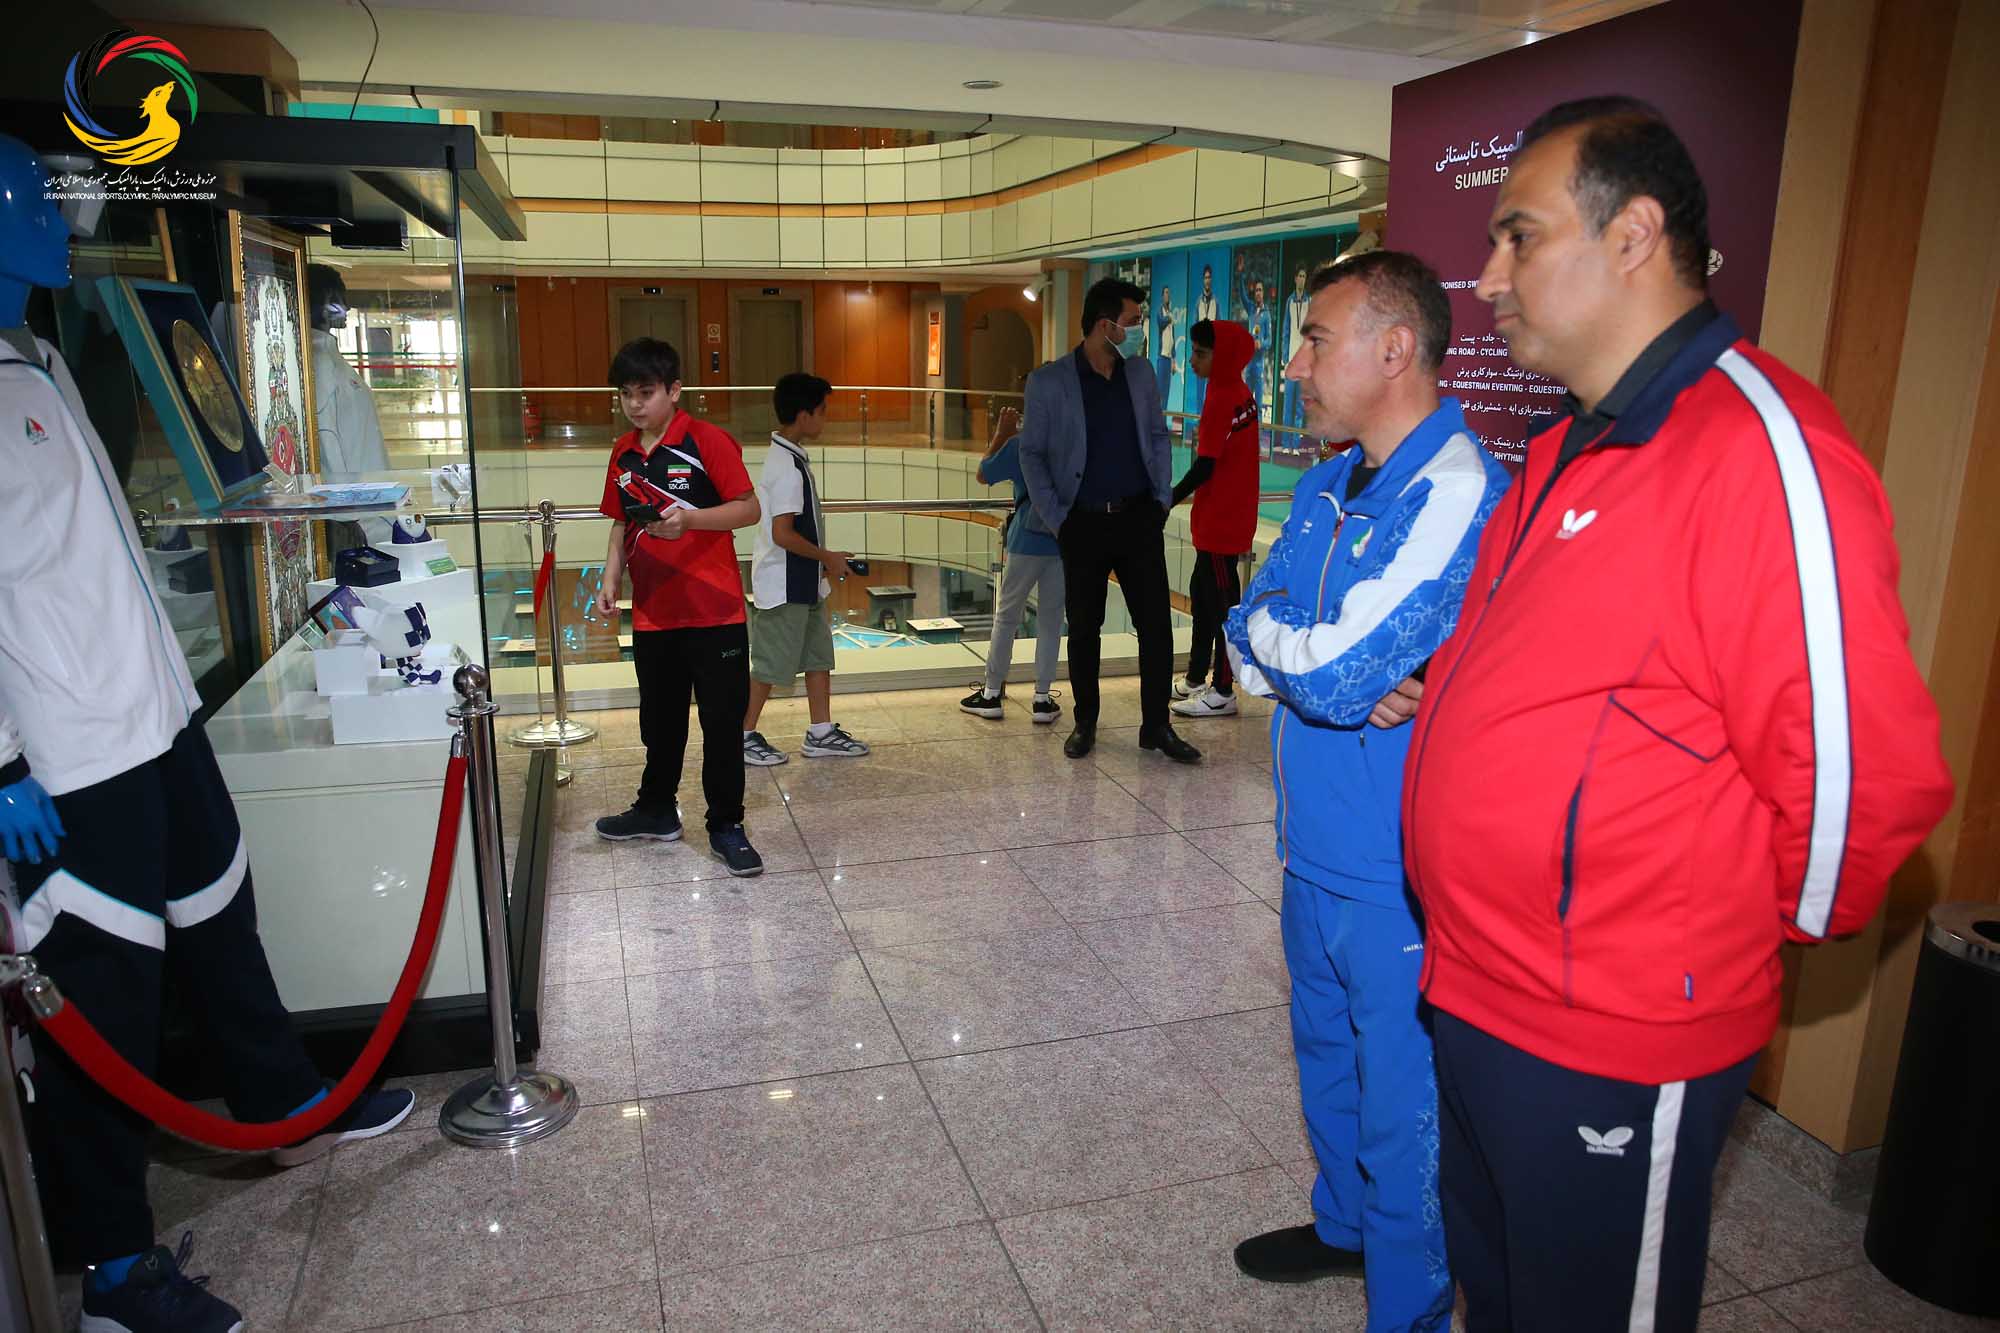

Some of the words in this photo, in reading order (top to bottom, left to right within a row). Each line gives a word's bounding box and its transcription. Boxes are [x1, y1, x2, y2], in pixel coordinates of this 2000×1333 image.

[1435, 140, 1480, 172] تابستانی
[1440, 280, 1467, 290] RONISED
[1458, 347, 1476, 356] ROAD
[1480, 348, 1508, 357] CYCLING
[1452, 380, 1491, 391] EQUESTRIAN
[1491, 382, 1523, 393] EVENTING
[1529, 384, 1568, 395] EQUESTRIA
[1494, 451, 1524, 464] RHYTHMI
